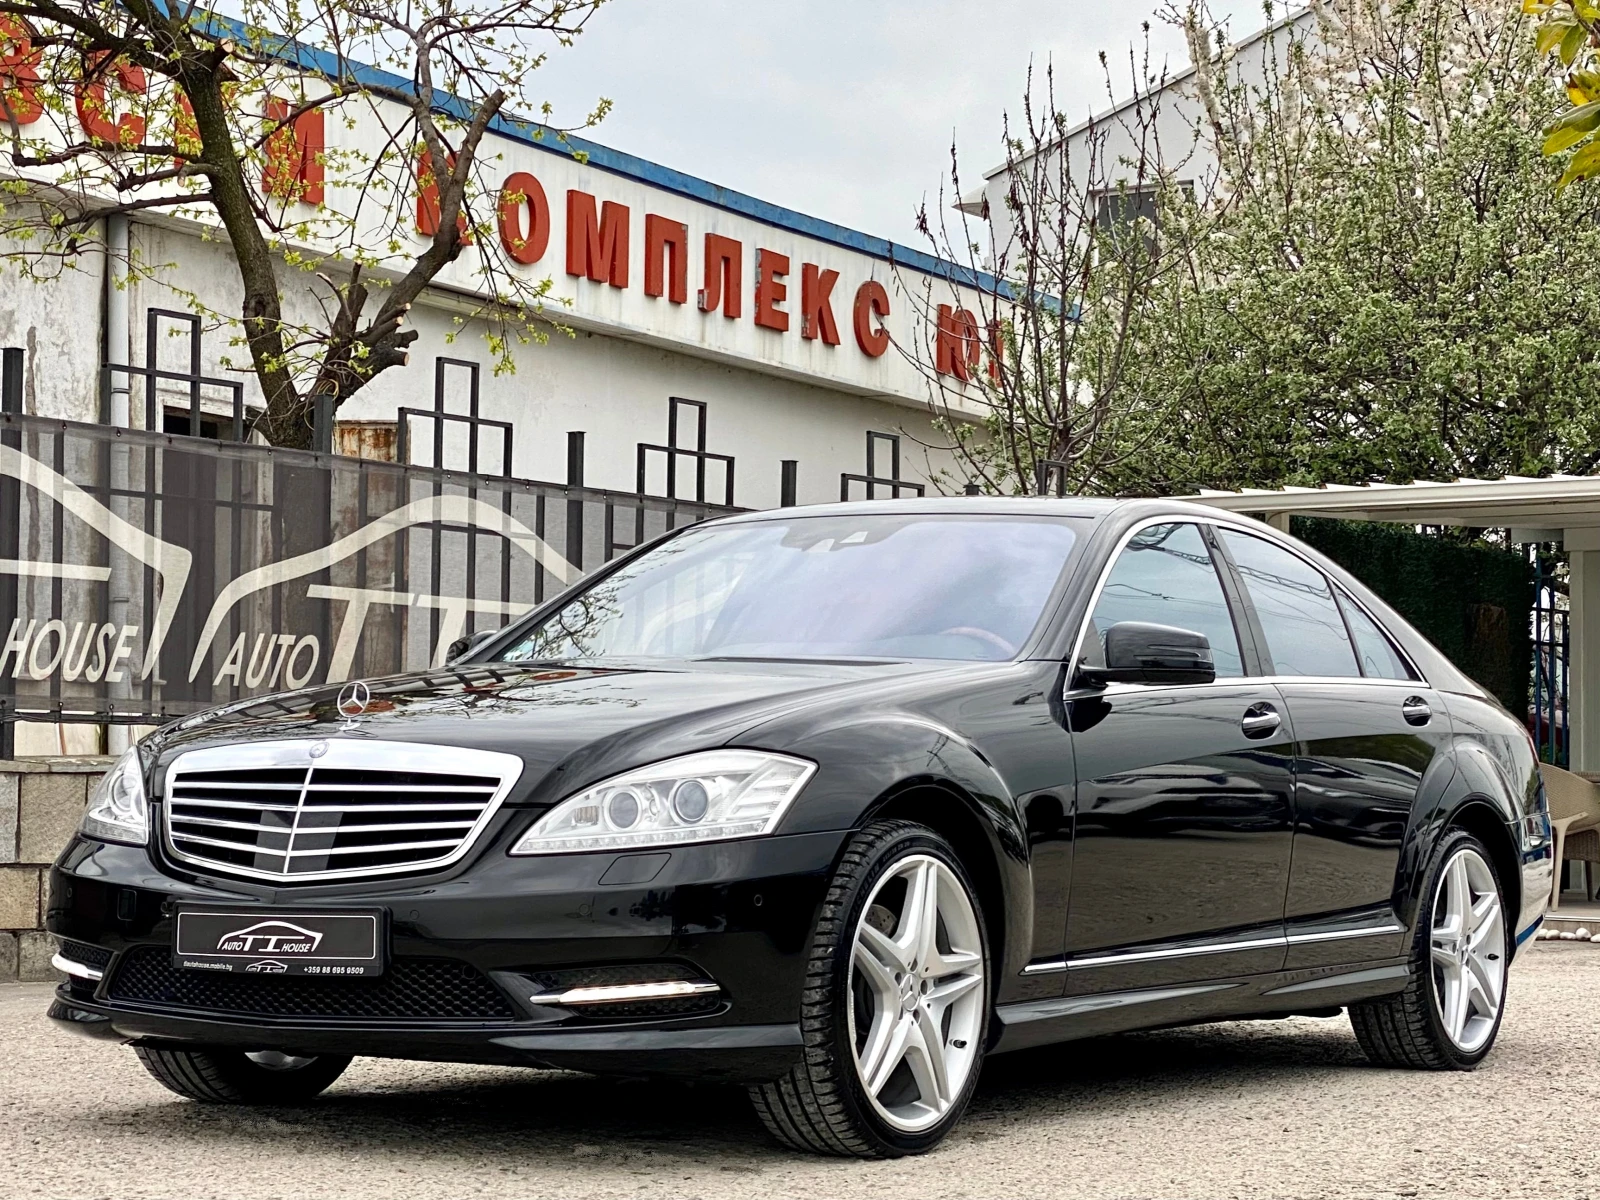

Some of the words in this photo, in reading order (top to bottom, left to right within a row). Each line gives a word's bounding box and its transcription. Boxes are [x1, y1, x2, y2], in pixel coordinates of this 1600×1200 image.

[0, 618, 139, 684] HOUSE
[213, 631, 320, 690] AUTO
[222, 941, 243, 951] AUTO
[281, 943, 311, 953] HOUSE
[303, 966, 321, 974] +359
[332, 966, 345, 974] 695
